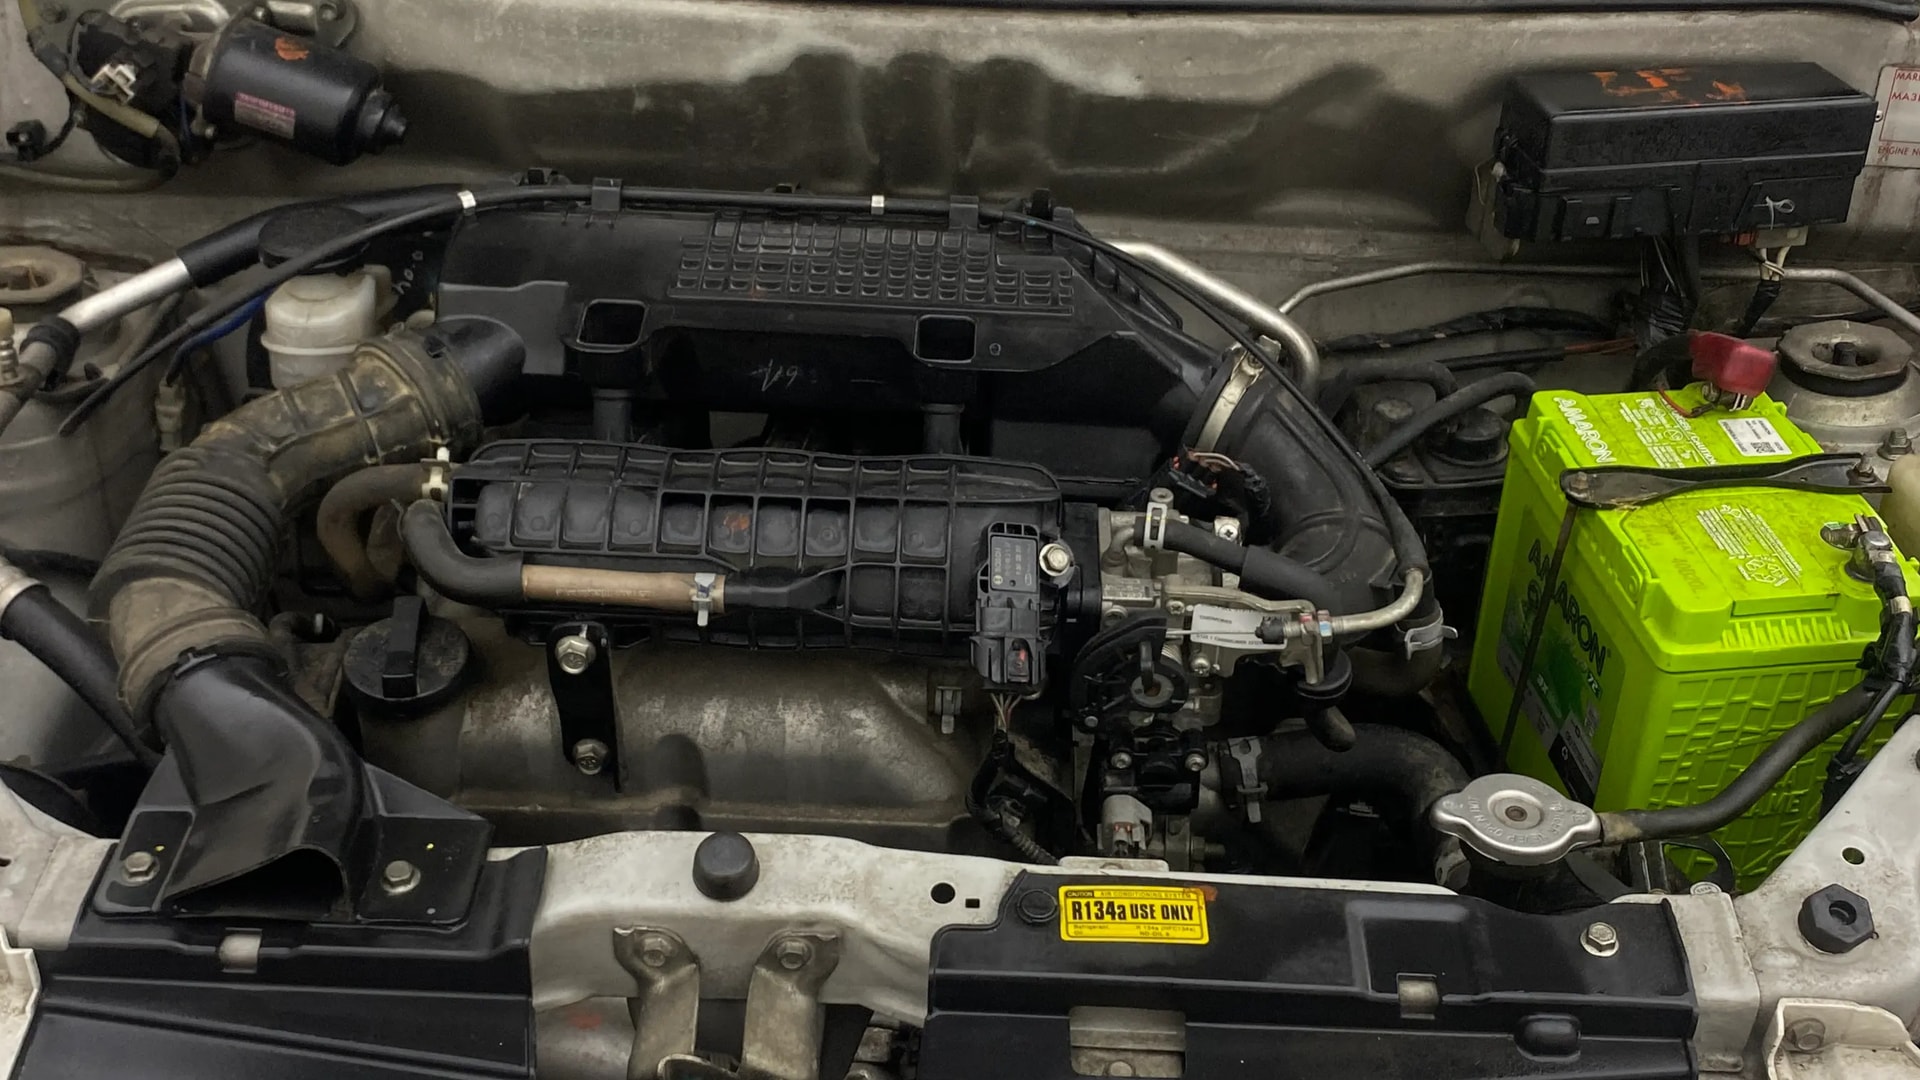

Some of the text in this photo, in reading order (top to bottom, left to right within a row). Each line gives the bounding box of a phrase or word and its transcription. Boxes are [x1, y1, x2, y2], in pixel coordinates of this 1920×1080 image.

[1895, 72, 1920, 81] MAR
[1891, 92, 1920, 102] MA3
[1877, 145, 1908, 156] ENGINE
[1553, 397, 1617, 464] AMARON
[1071, 900, 1194, 921] R134a USE ONLY
